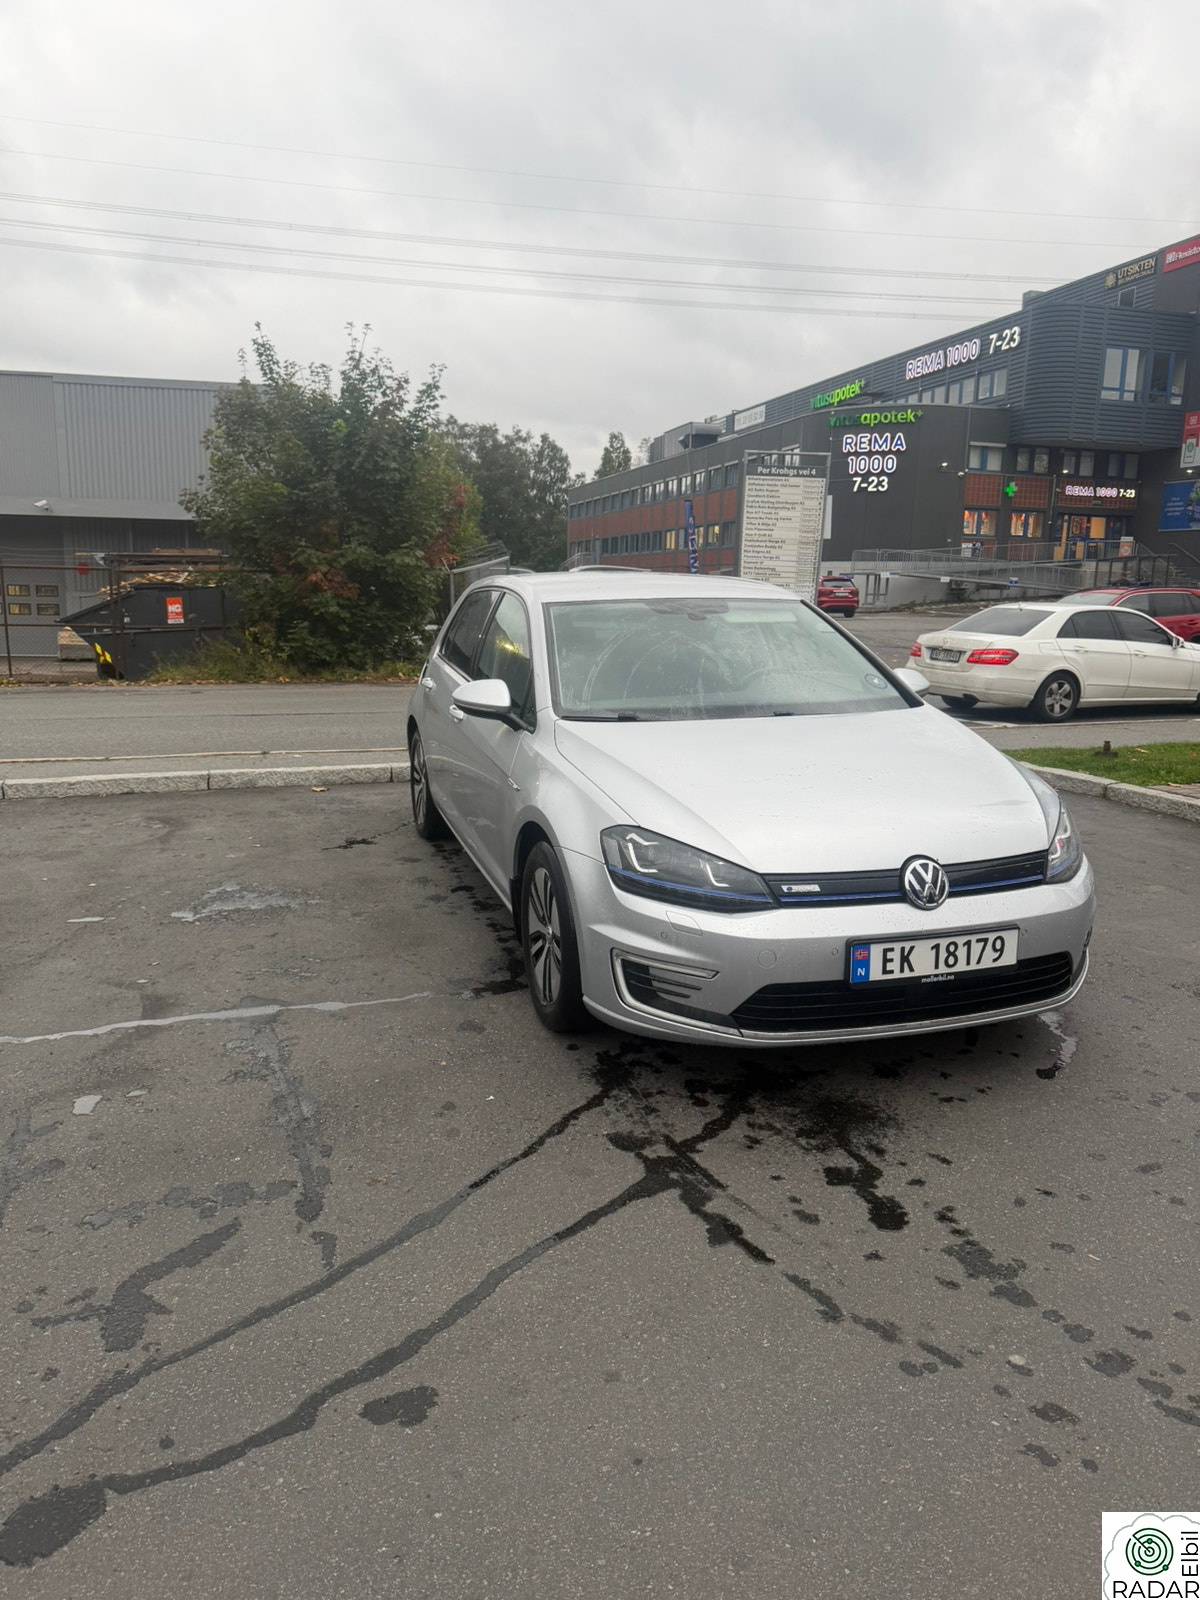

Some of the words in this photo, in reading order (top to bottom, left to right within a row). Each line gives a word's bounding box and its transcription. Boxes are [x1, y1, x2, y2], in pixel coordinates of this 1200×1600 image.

[1117, 257, 1156, 279] UTSIKTEN
[905, 350, 944, 380] REMA
[946, 339, 980, 367] 1000
[989, 326, 1020, 354] 7-23
[842, 433, 907, 453] REMA
[757, 466, 770, 474] Per
[771, 467, 798, 476] Krohgs
[811, 468, 816, 476] 4
[848, 455, 897, 474] 1000
[852, 476, 889, 492] 7-23
[1065, 485, 1095, 497] REMA
[1096, 487, 1118, 497] 1000
[1119, 489, 1136, 498] 7-23
[857, 968, 865, 976] N
[881, 945, 916, 975] EK
[930, 935, 1006, 970] 18179
